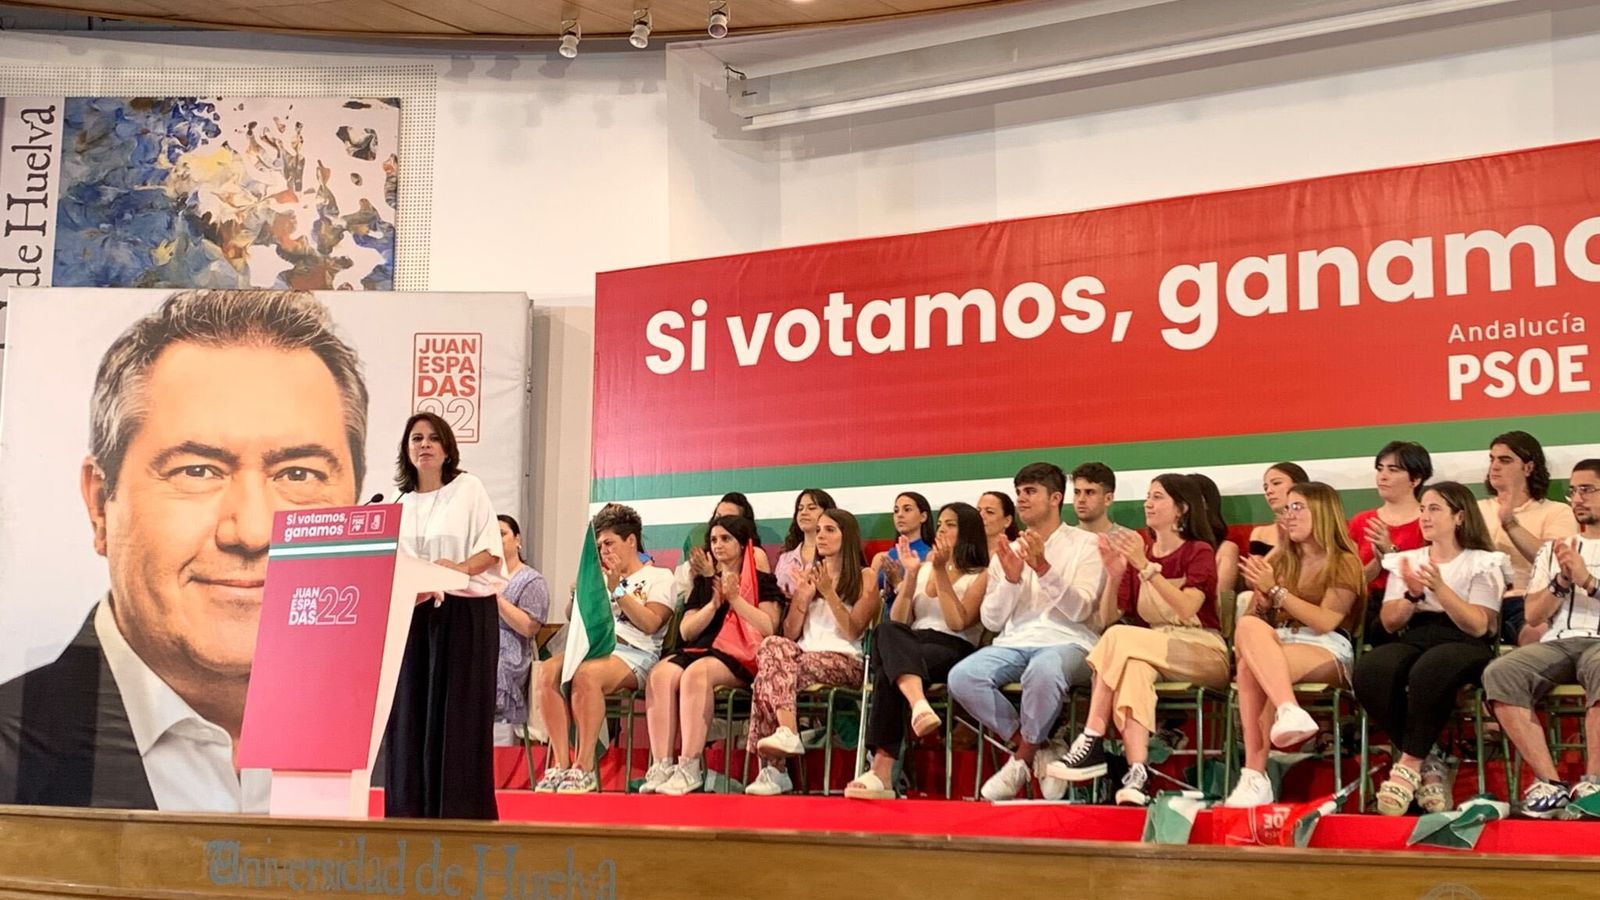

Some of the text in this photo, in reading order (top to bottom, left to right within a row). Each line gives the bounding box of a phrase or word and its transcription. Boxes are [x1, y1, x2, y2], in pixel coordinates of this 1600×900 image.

[0, 104, 56, 288] de Huelva
[645, 299, 709, 375] Si
[727, 276, 1132, 367] votamos,
[1448, 312, 1586, 344] Andalucía
[418, 338, 477, 354] JUAN
[418, 356, 476, 374] ESPA
[1448, 344, 1591, 401] PSOE
[417, 375, 477, 397] DAS
[297, 512, 348, 524] votamos,
[284, 524, 344, 542] ganamos
[292, 587, 320, 599] JUAN
[290, 598, 318, 611] ESPA
[315, 585, 360, 625] 22
[288, 610, 317, 625] DAS
[205, 835, 617, 900] Universidad de Huelva
